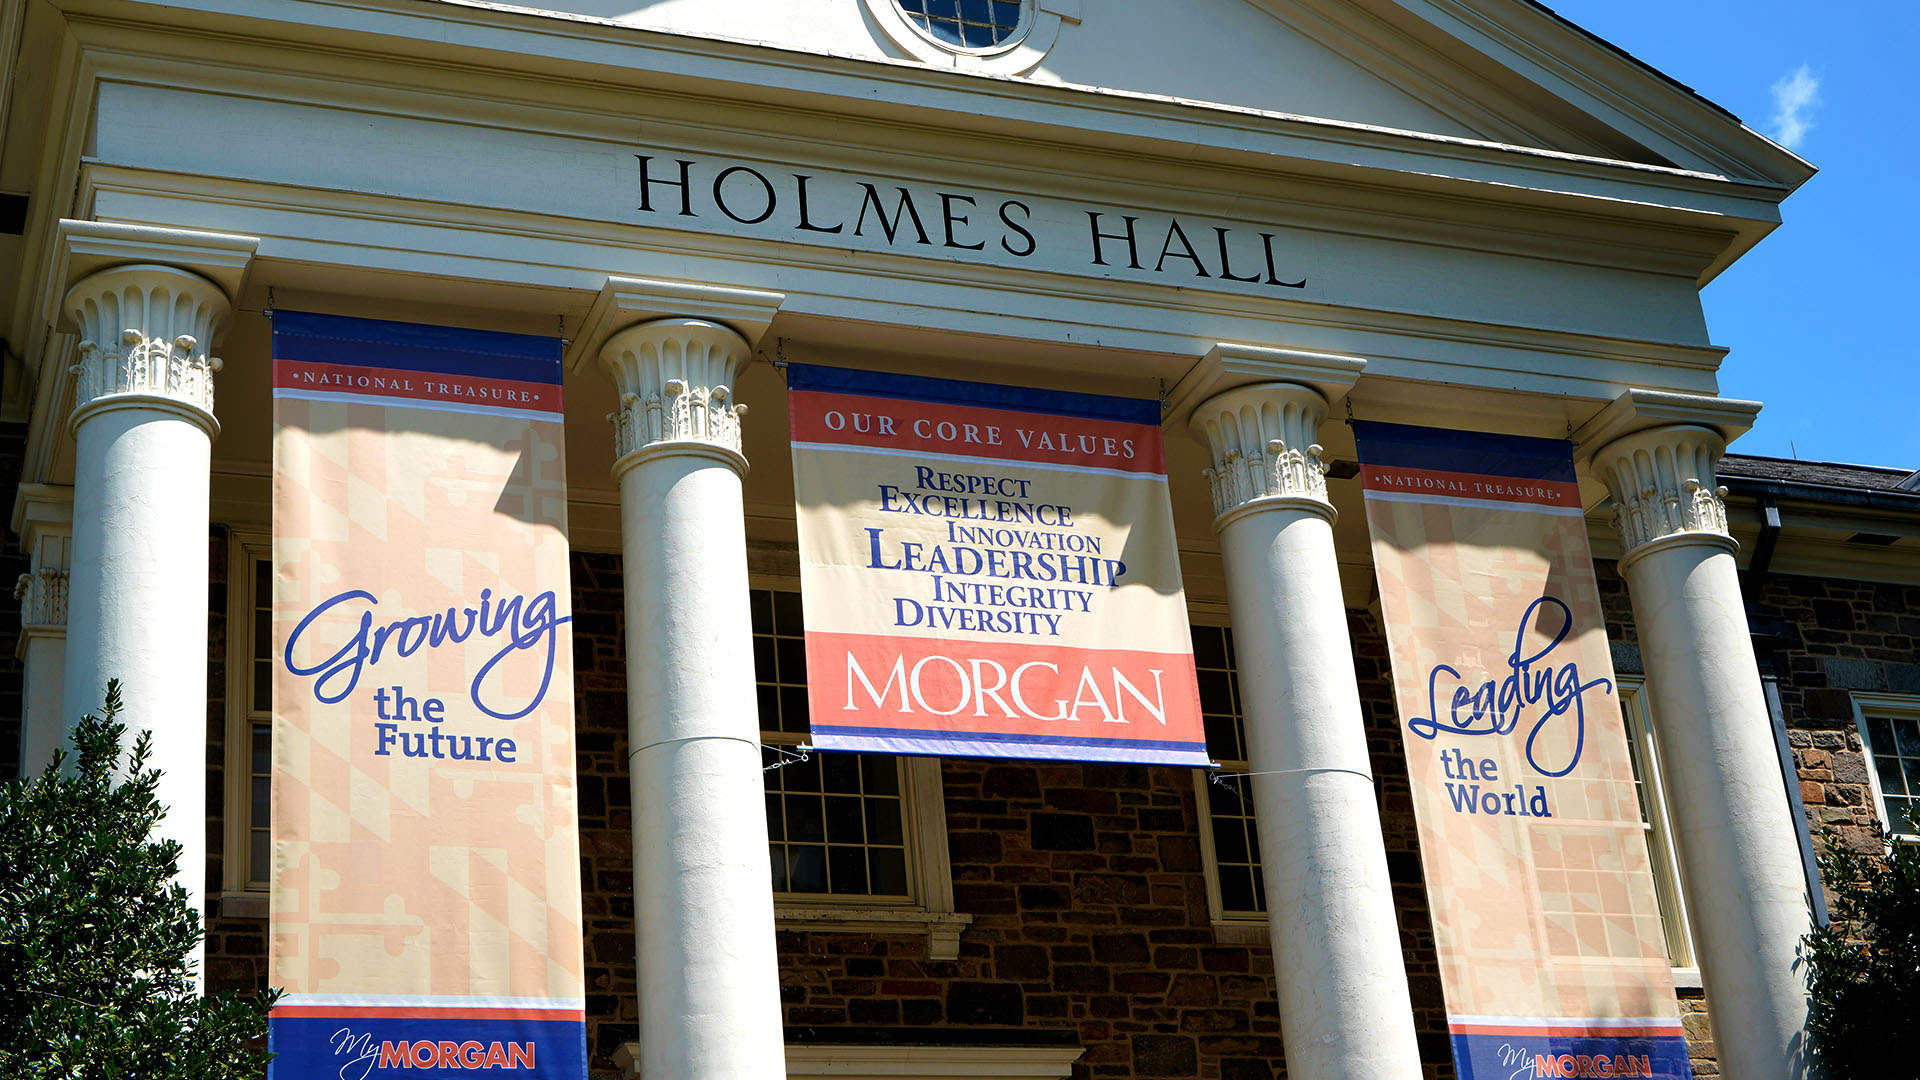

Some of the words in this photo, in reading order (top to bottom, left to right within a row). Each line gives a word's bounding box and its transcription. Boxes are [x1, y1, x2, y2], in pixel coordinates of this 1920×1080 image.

[634, 154, 1036, 257] HOLMES
[1085, 211, 1307, 288] HALL
[303, 371, 414, 392] NATIONAL
[424, 381, 531, 402] TREASURE
[825, 410, 898, 436] OUR
[913, 419, 1003, 446] CORE
[1015, 428, 1136, 459] VALUES
[1383, 474, 1467, 492] NATIONAL
[1474, 482, 1555, 499] TREASURE
[285, 588, 572, 720] Growing
[373, 686, 445, 723] the
[843, 650, 1165, 726] MORGAN
[1408, 596, 1612, 778] Leading
[373, 723, 517, 763] Future
[1440, 748, 1498, 781] the
[1444, 783, 1552, 818] World
